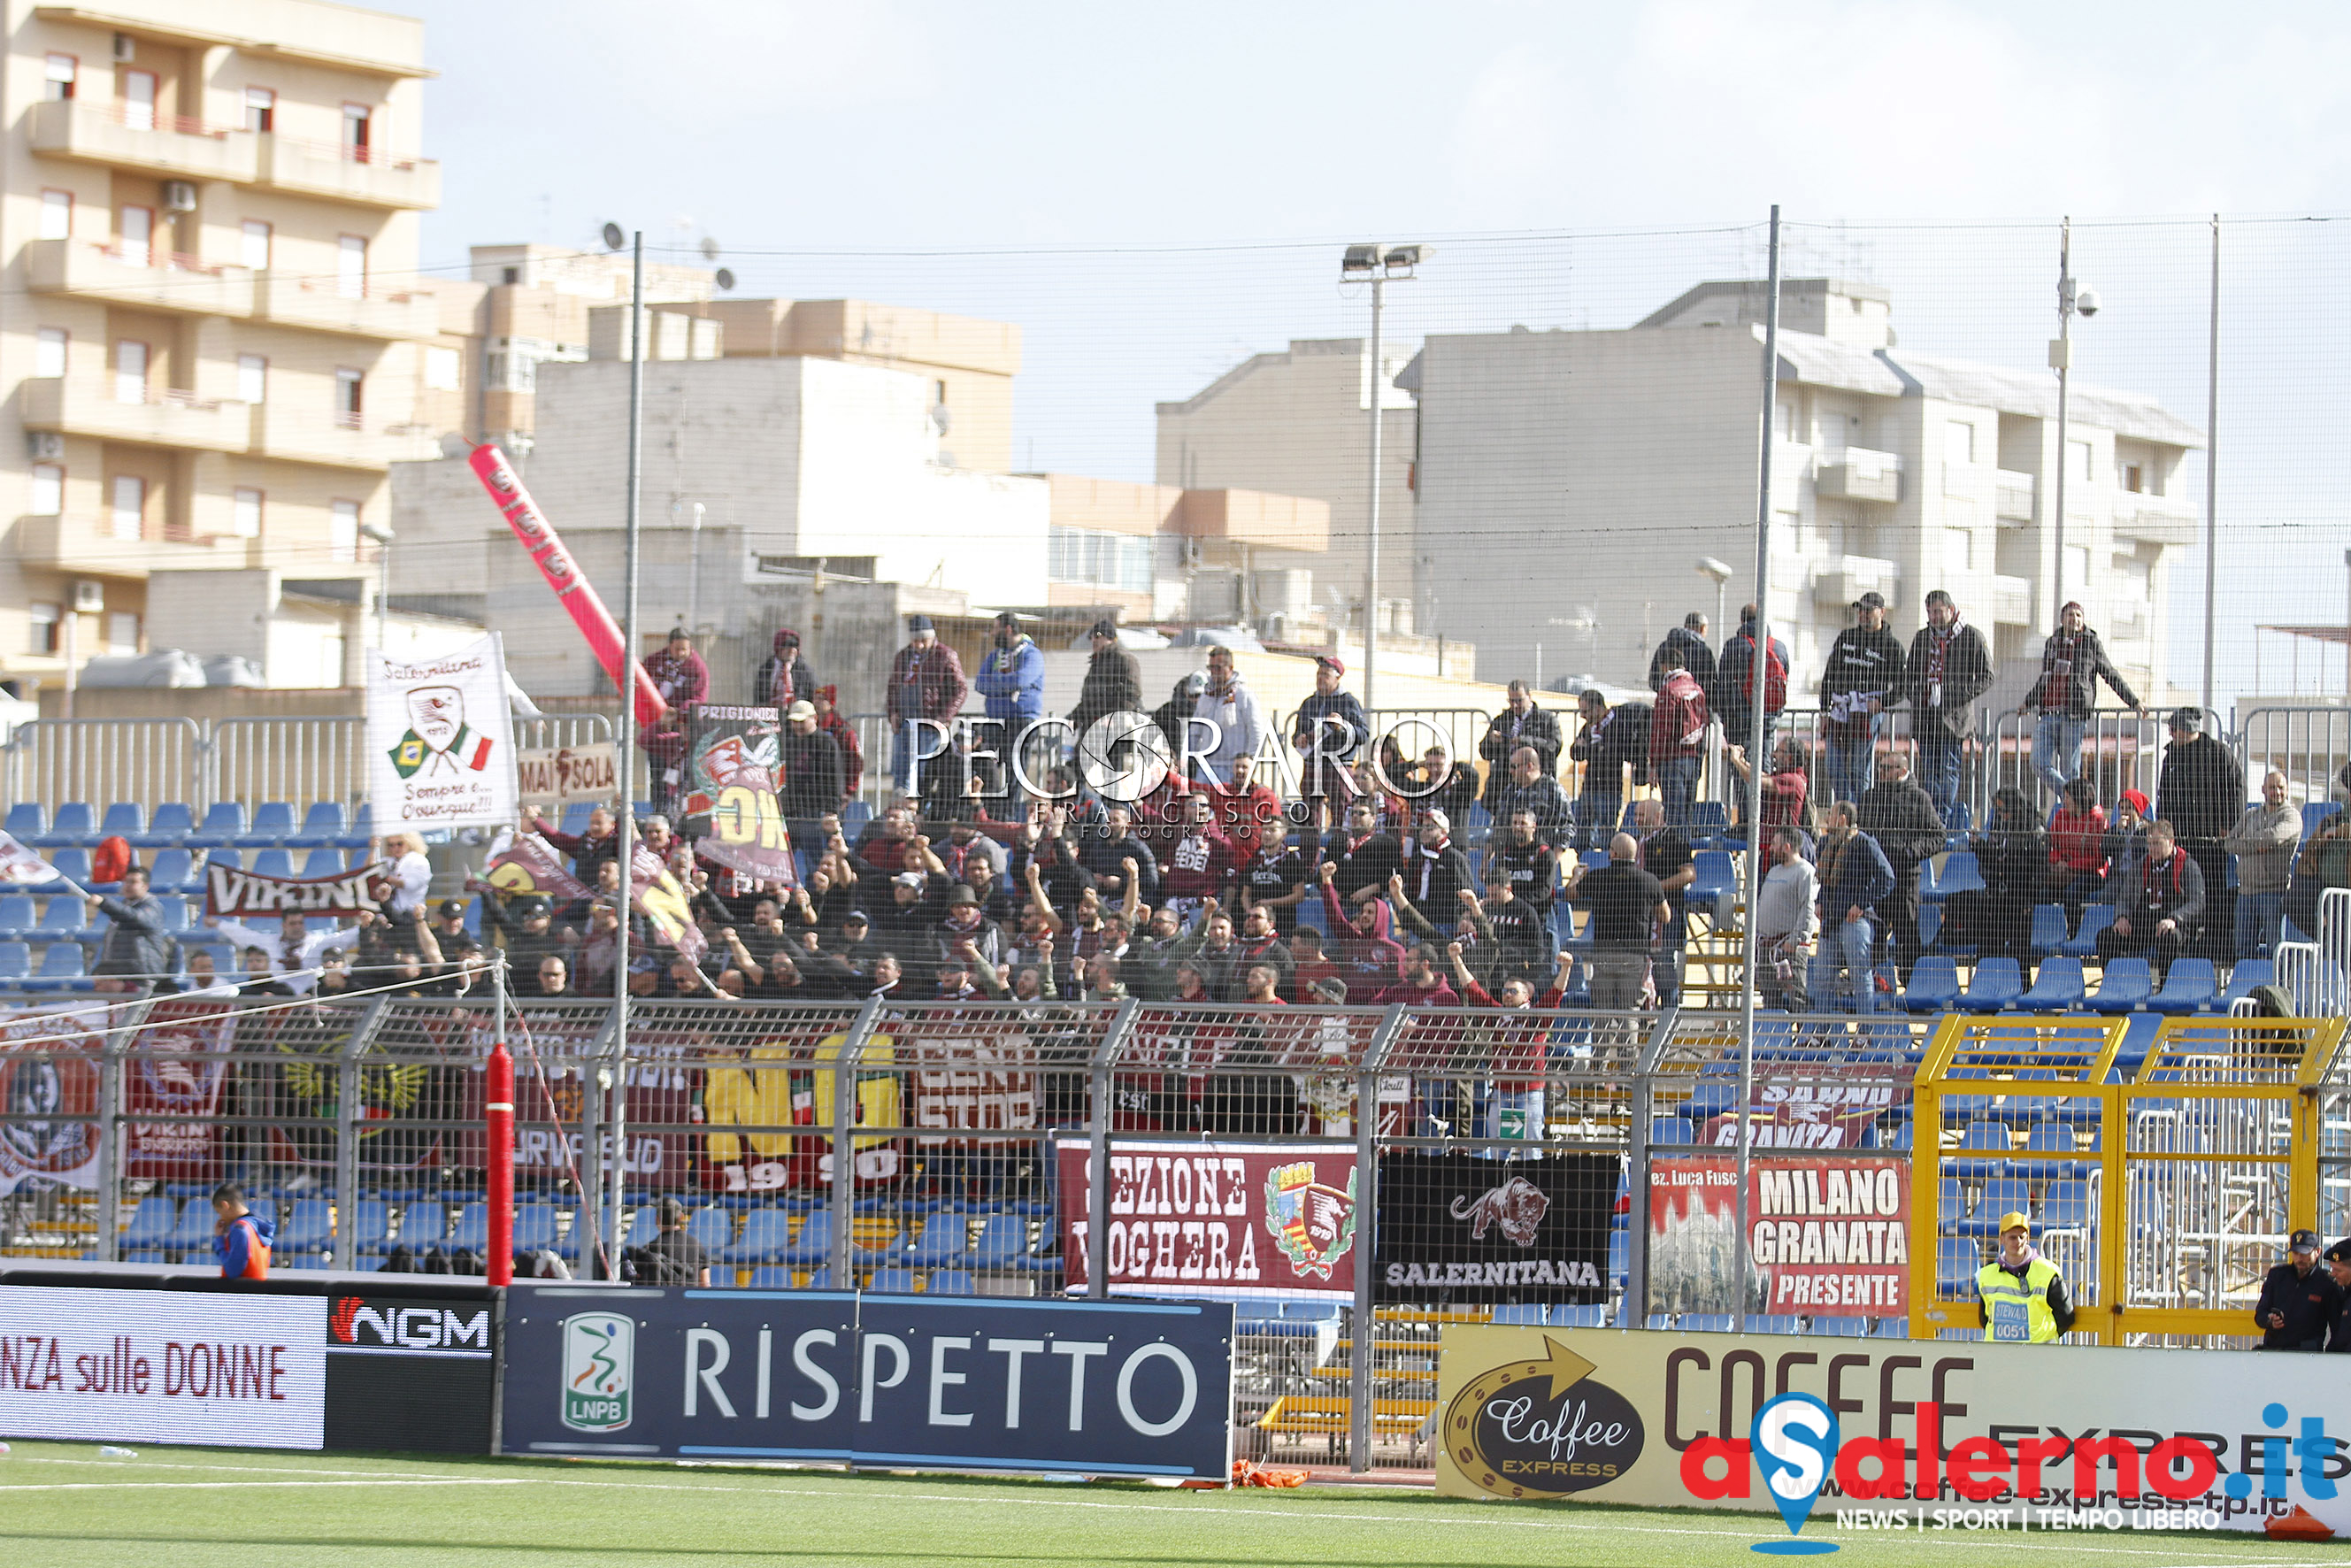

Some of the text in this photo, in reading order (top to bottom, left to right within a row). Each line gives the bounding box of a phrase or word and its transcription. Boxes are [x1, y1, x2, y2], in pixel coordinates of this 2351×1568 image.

[573, 755, 615, 788] SOLA
[404, 783, 465, 801] Sempre
[1085, 1156, 1247, 1217] EZIONE
[1651, 1169, 1738, 1186] ez. Luca Fusc
[1759, 1167, 1899, 1216] MILANO
[1310, 1225, 1333, 1240] 1919
[1752, 1219, 1908, 1265] GRANATA
[1387, 1260, 1601, 1287] SALERNITANA
[1775, 1272, 1900, 1306] PRESENTE
[350, 1307, 489, 1349] NGM
[1996, 1324, 2026, 1339] 0051
[75, 1335, 150, 1394] sulle
[164, 1341, 285, 1401] DONNE
[684, 1328, 1199, 1437] RISPETTO
[572, 1400, 622, 1420] LNPB
[1664, 1346, 1975, 1463] COFFEE
[1487, 1395, 1631, 1462] Coffee
[1502, 1459, 1618, 1478] EXPRESS
